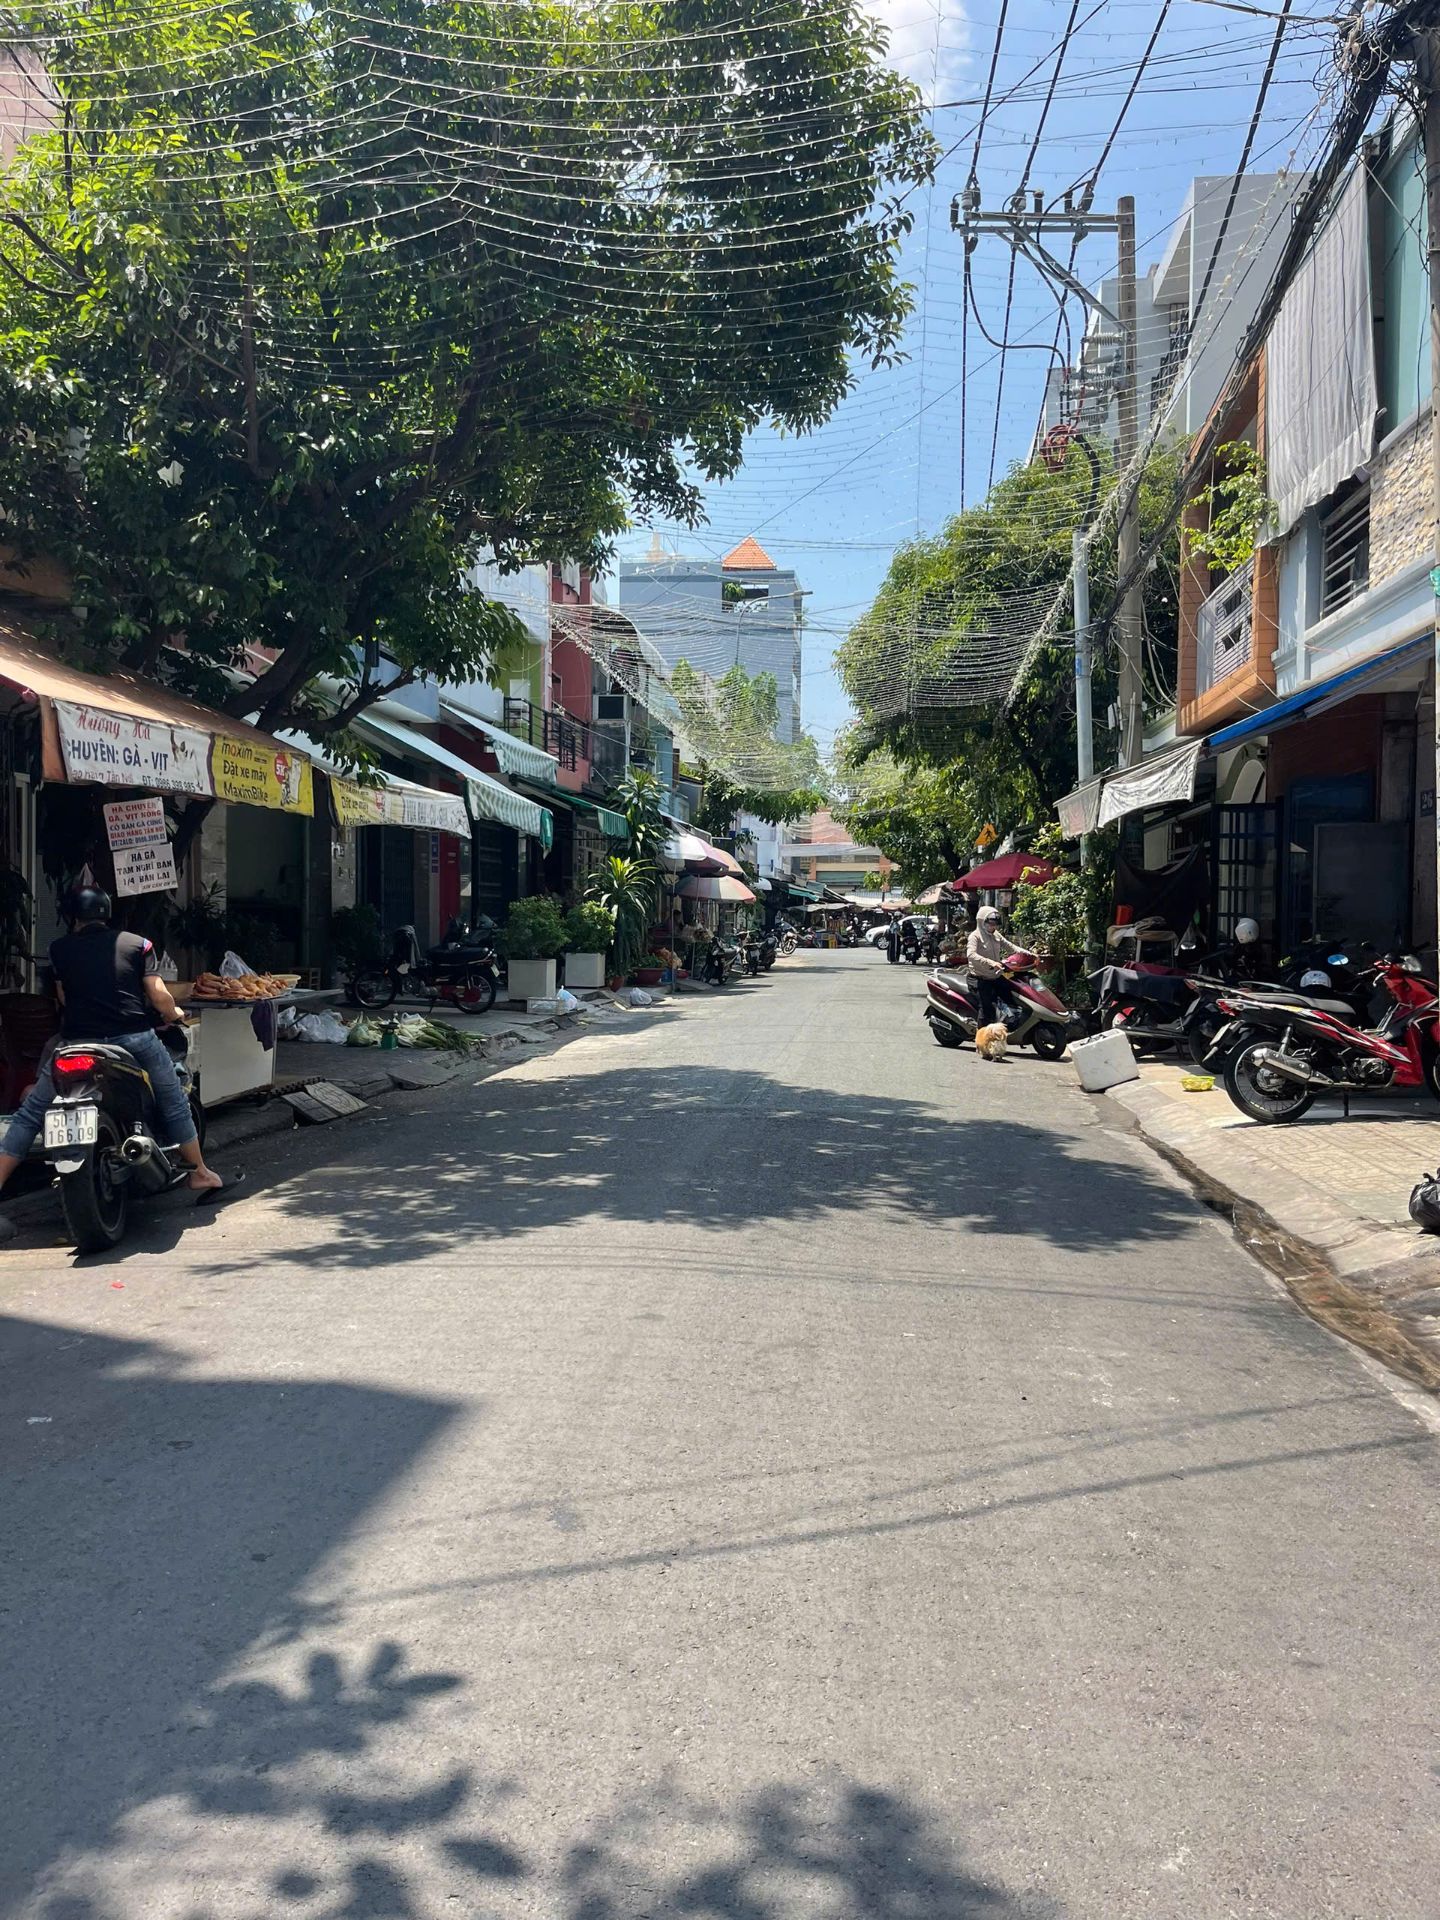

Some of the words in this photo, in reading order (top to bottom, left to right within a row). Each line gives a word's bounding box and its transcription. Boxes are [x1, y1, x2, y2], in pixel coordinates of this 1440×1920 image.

[122, 743, 142, 768] GÀ
[151, 751, 169, 775] VỊT
[221, 742, 253, 761] maxim
[223, 759, 239, 779] Đặt
[240, 766, 250, 777] xe
[251, 766, 268, 785] máy
[223, 781, 269, 802] MaximBike
[53, 1111, 88, 1128] 50-N1
[48, 1127, 94, 1145] 166.09
